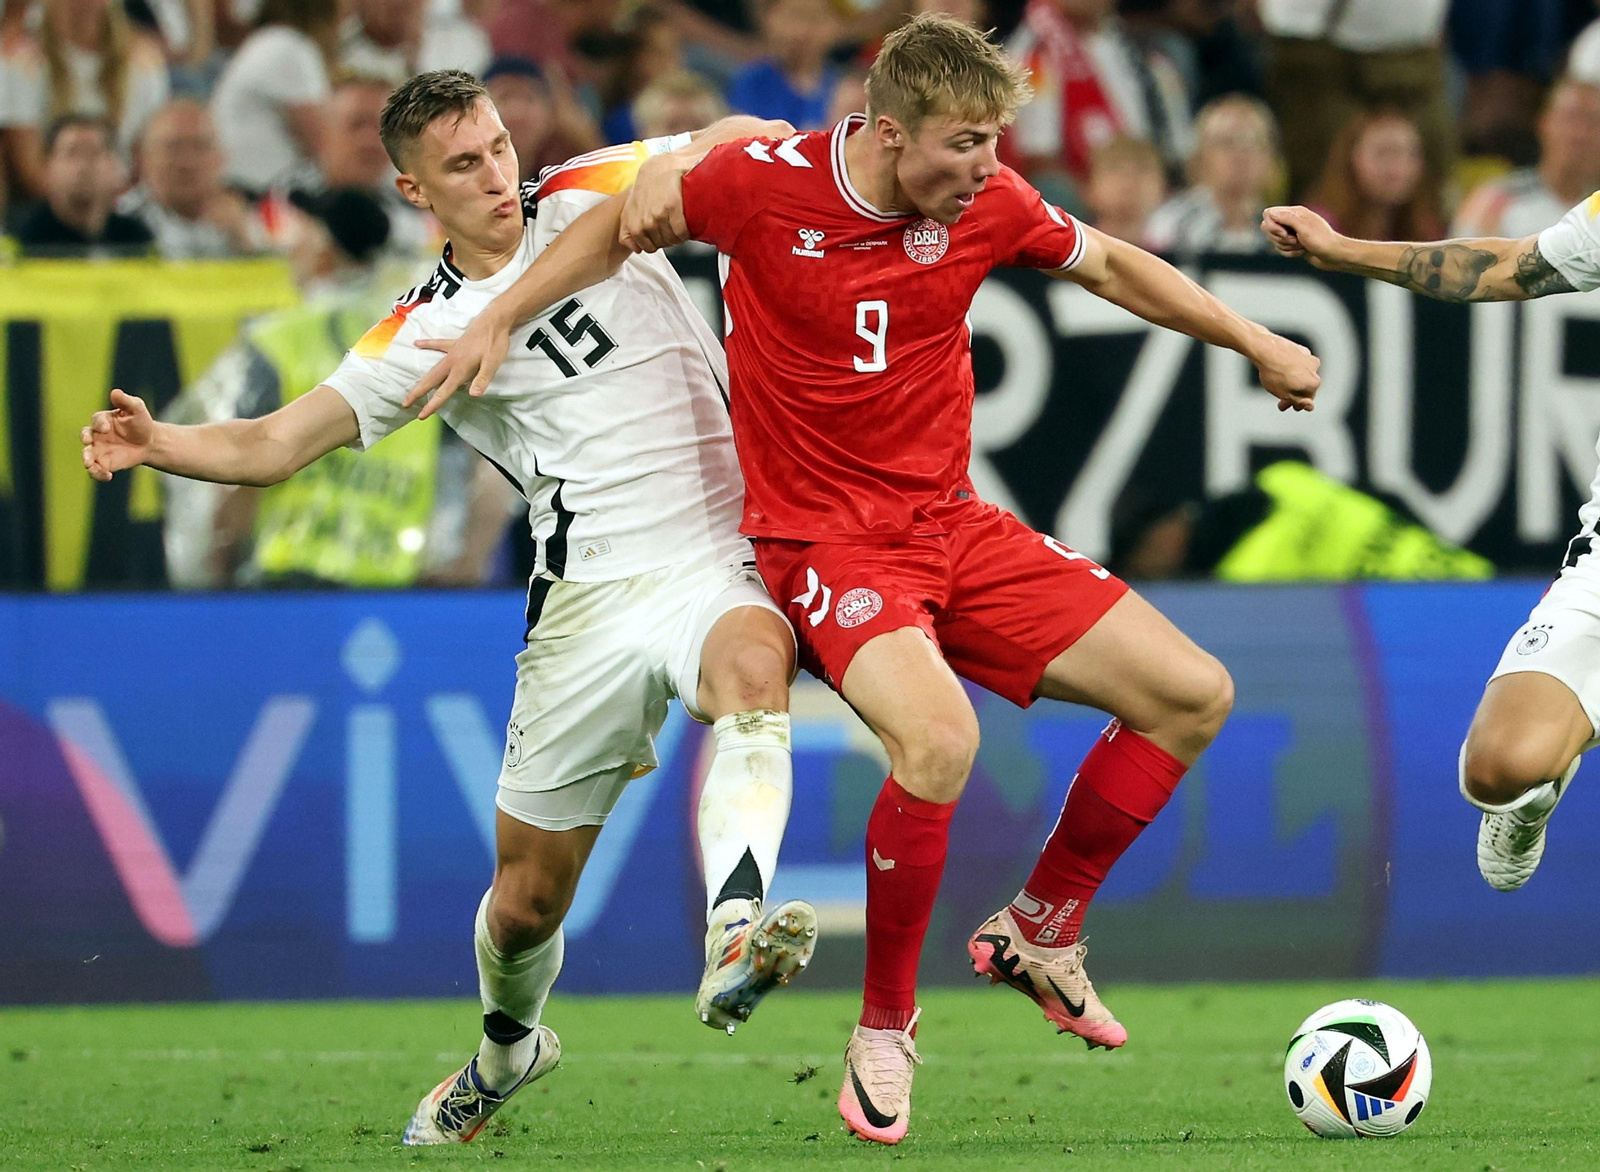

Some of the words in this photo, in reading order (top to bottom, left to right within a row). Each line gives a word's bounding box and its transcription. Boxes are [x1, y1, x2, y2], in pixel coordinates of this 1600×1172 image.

[913, 229, 940, 246] DBU
[791, 245, 825, 259] hummel
[525, 297, 619, 378] 15
[854, 300, 888, 373] 9
[842, 596, 873, 618] DBU
